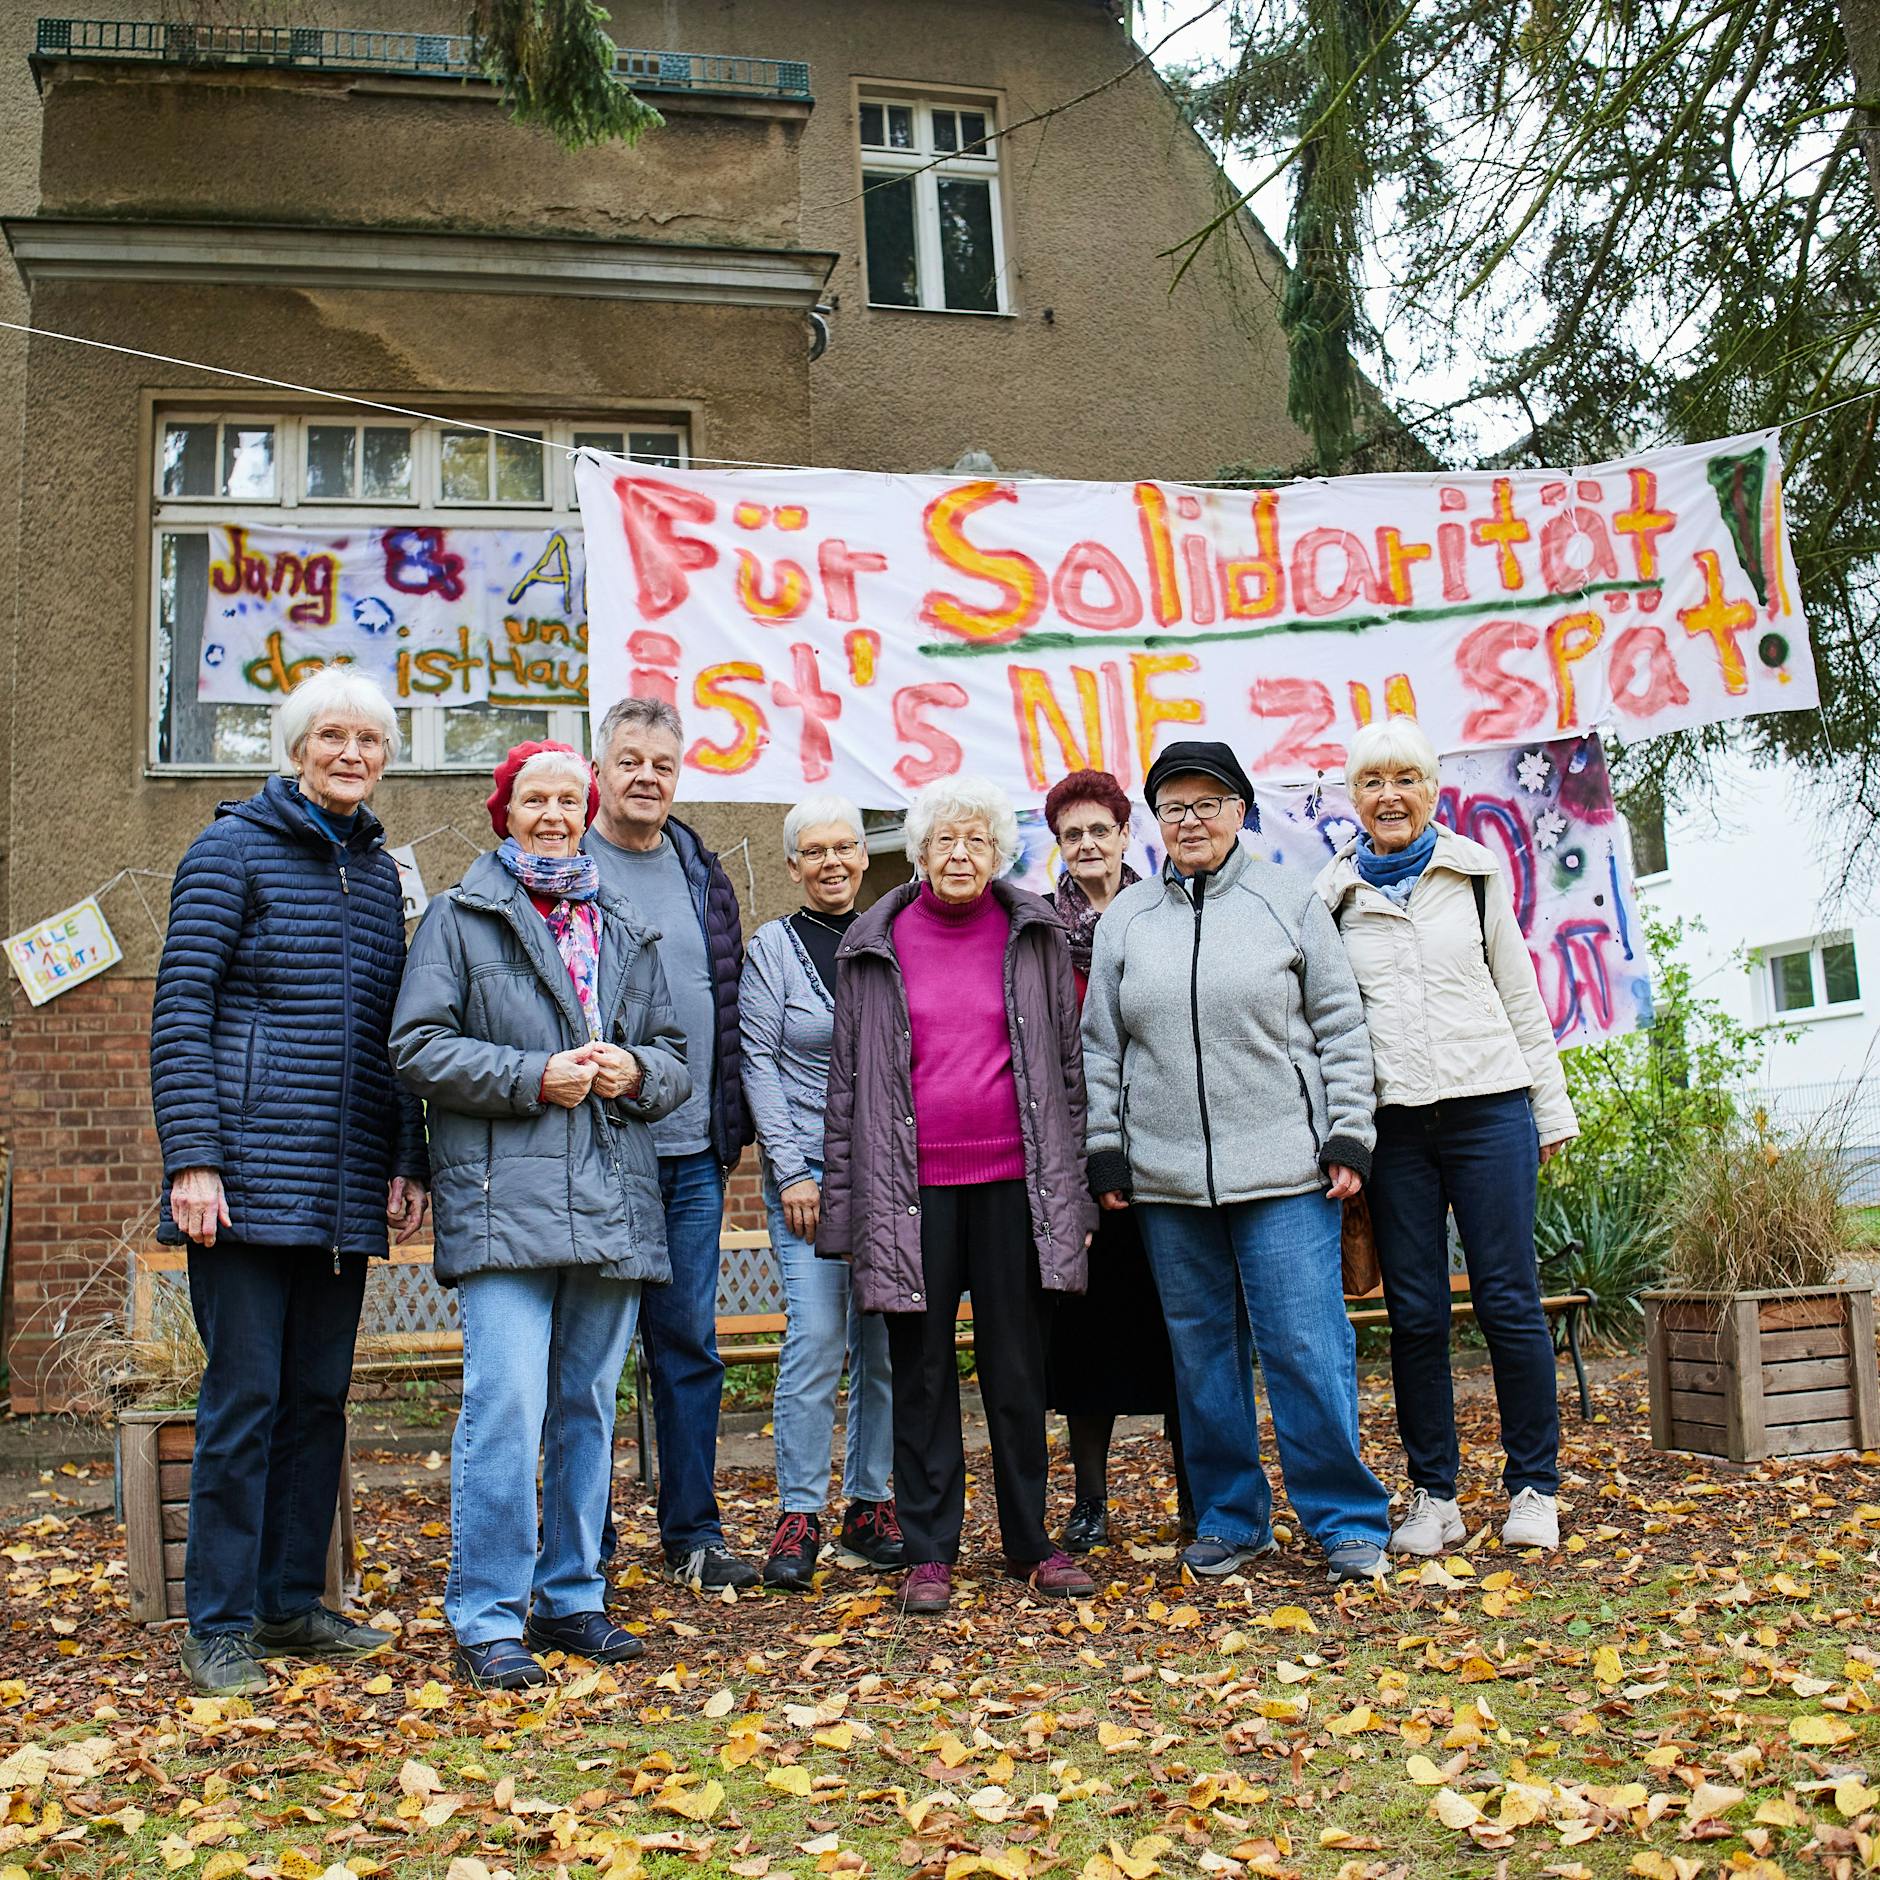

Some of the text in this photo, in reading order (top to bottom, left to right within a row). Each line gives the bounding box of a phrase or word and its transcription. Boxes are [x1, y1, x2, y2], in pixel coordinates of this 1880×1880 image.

[211, 523, 340, 626] Jung
[507, 532, 588, 615] A
[612, 467, 1677, 643] Für Solidarität
[396, 625, 484, 698] ist
